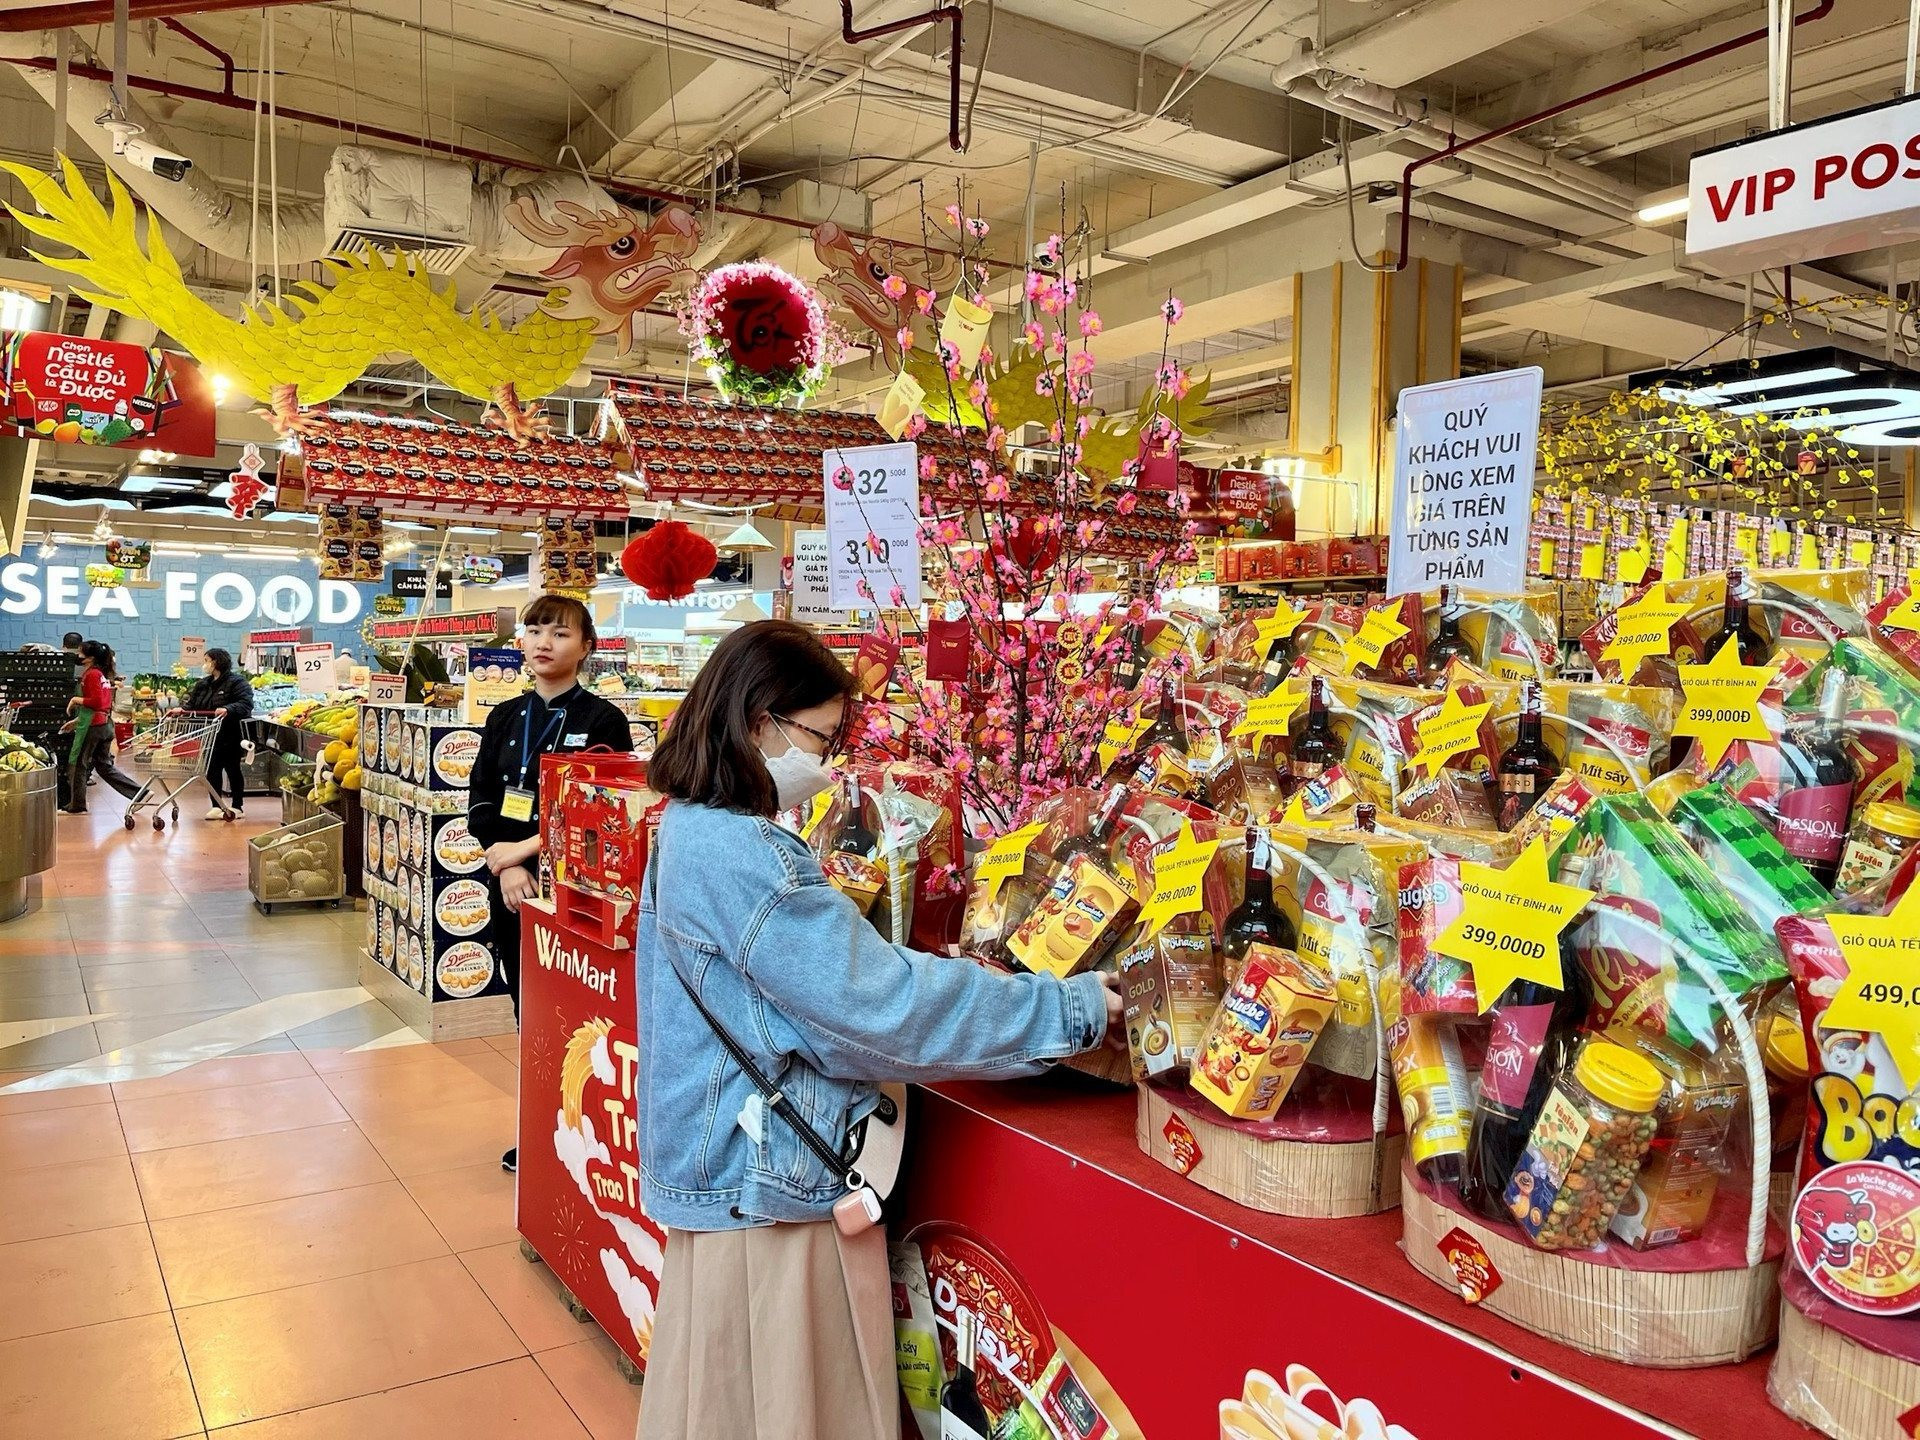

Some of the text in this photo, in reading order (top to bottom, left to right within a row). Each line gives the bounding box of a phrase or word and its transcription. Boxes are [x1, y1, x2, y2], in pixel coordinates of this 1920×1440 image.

[1706, 168, 1796, 223] VIP
[46, 346, 115, 369] Nestlé
[61, 341, 91, 353] Chọn
[44, 363, 127, 387] Cầu Đủ
[45, 378, 117, 403] là Được
[1444, 403, 1489, 431] QUÝ
[1408, 432, 1521, 465] KHÁCH VUI
[1410, 464, 1516, 494] LÒNG XEM
[1414, 493, 1506, 523] GIÁ TRÊN
[1406, 521, 1509, 553] TỪNG SẢN
[846, 538, 909, 565] 310 000đ
[805, 563, 821, 571] GIÁ
[1425, 553, 1485, 581] PHẨM
[1, 562, 362, 625] SEA FOOD
[623, 587, 695, 608] FRON
[797, 605, 811, 613] XIN
[1616, 632, 1662, 646] 399,000Đ
[186, 646, 197, 654] 99
[304, 660, 322, 672] 29
[1681, 677, 1694, 686] GIỎ
[1694, 678, 1710, 687] QUÀ
[1711, 677, 1724, 686] TẾT
[1725, 677, 1744, 686] BÌNH
[377, 688, 393, 699] 20
[1690, 708, 1751, 723] 399,000Đ
[442, 739, 480, 755] Danisa
[1579, 763, 1630, 785] Mít sấy
[646, 815, 662, 824] NESC
[1778, 818, 1837, 834] PASSION
[443, 829, 468, 842] Dan
[1192, 854, 1210, 866] KHANG
[445, 888, 482, 905] Danisa
[1154, 884, 1197, 904] 399,000Đ
[1398, 883, 1448, 910] sugus
[1462, 882, 1563, 915] GIỎ QUÀ TẾT BÌNH AN
[1300, 933, 1318, 954] Mít
[1462, 924, 1546, 959] 399,000Đ
[1841, 933, 1865, 946] GIỎ
[1868, 935, 1896, 949] QUÀ
[445, 950, 483, 968] Danisa
[533, 922, 618, 1001] WinMart
[1128, 977, 1156, 999] GOLD
[591, 1172, 624, 1203] Trao
[1856, 1172, 1887, 1187] Vache
[933, 1276, 1022, 1376] Disy
